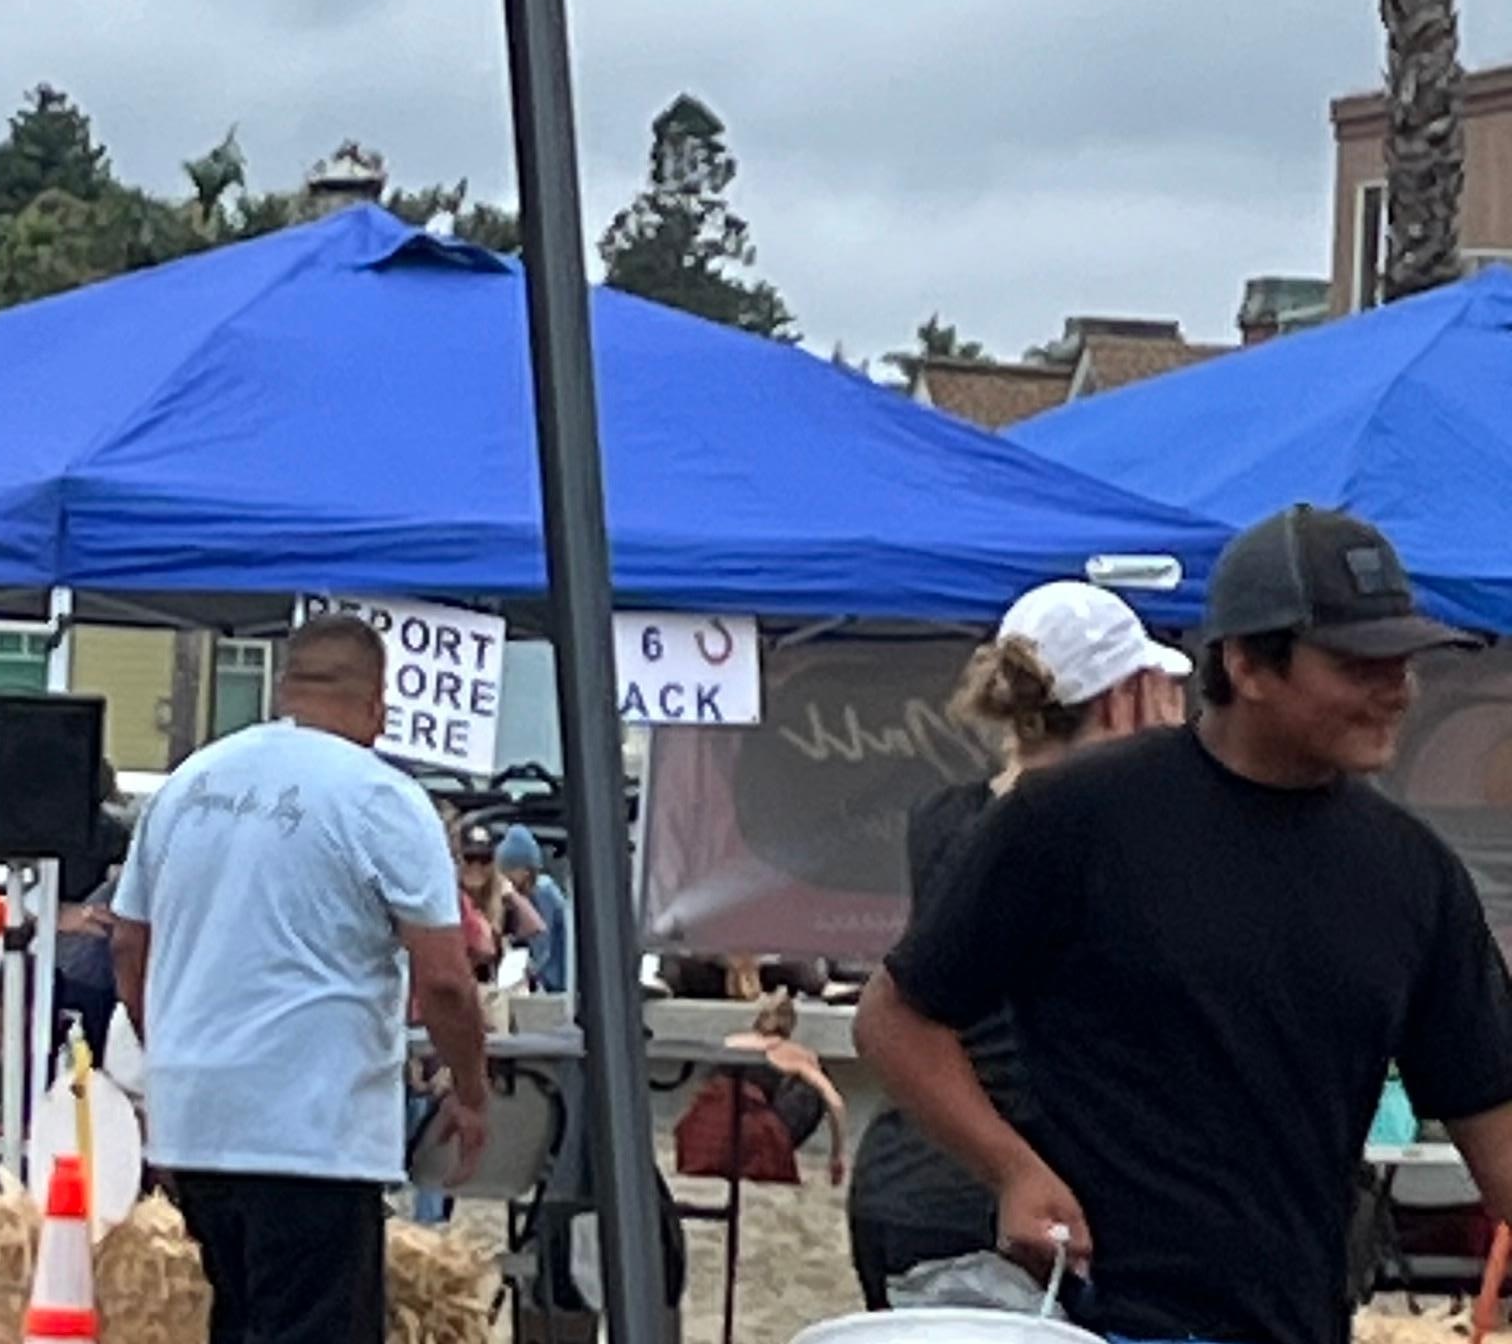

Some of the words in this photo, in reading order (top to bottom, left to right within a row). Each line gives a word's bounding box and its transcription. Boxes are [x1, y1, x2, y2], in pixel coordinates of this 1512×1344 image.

[304, 592, 496, 670] PORT
[642, 625, 664, 662] 6
[396, 663, 496, 718] ORE
[618, 681, 723, 722] ACK
[386, 705, 471, 758] ERE
